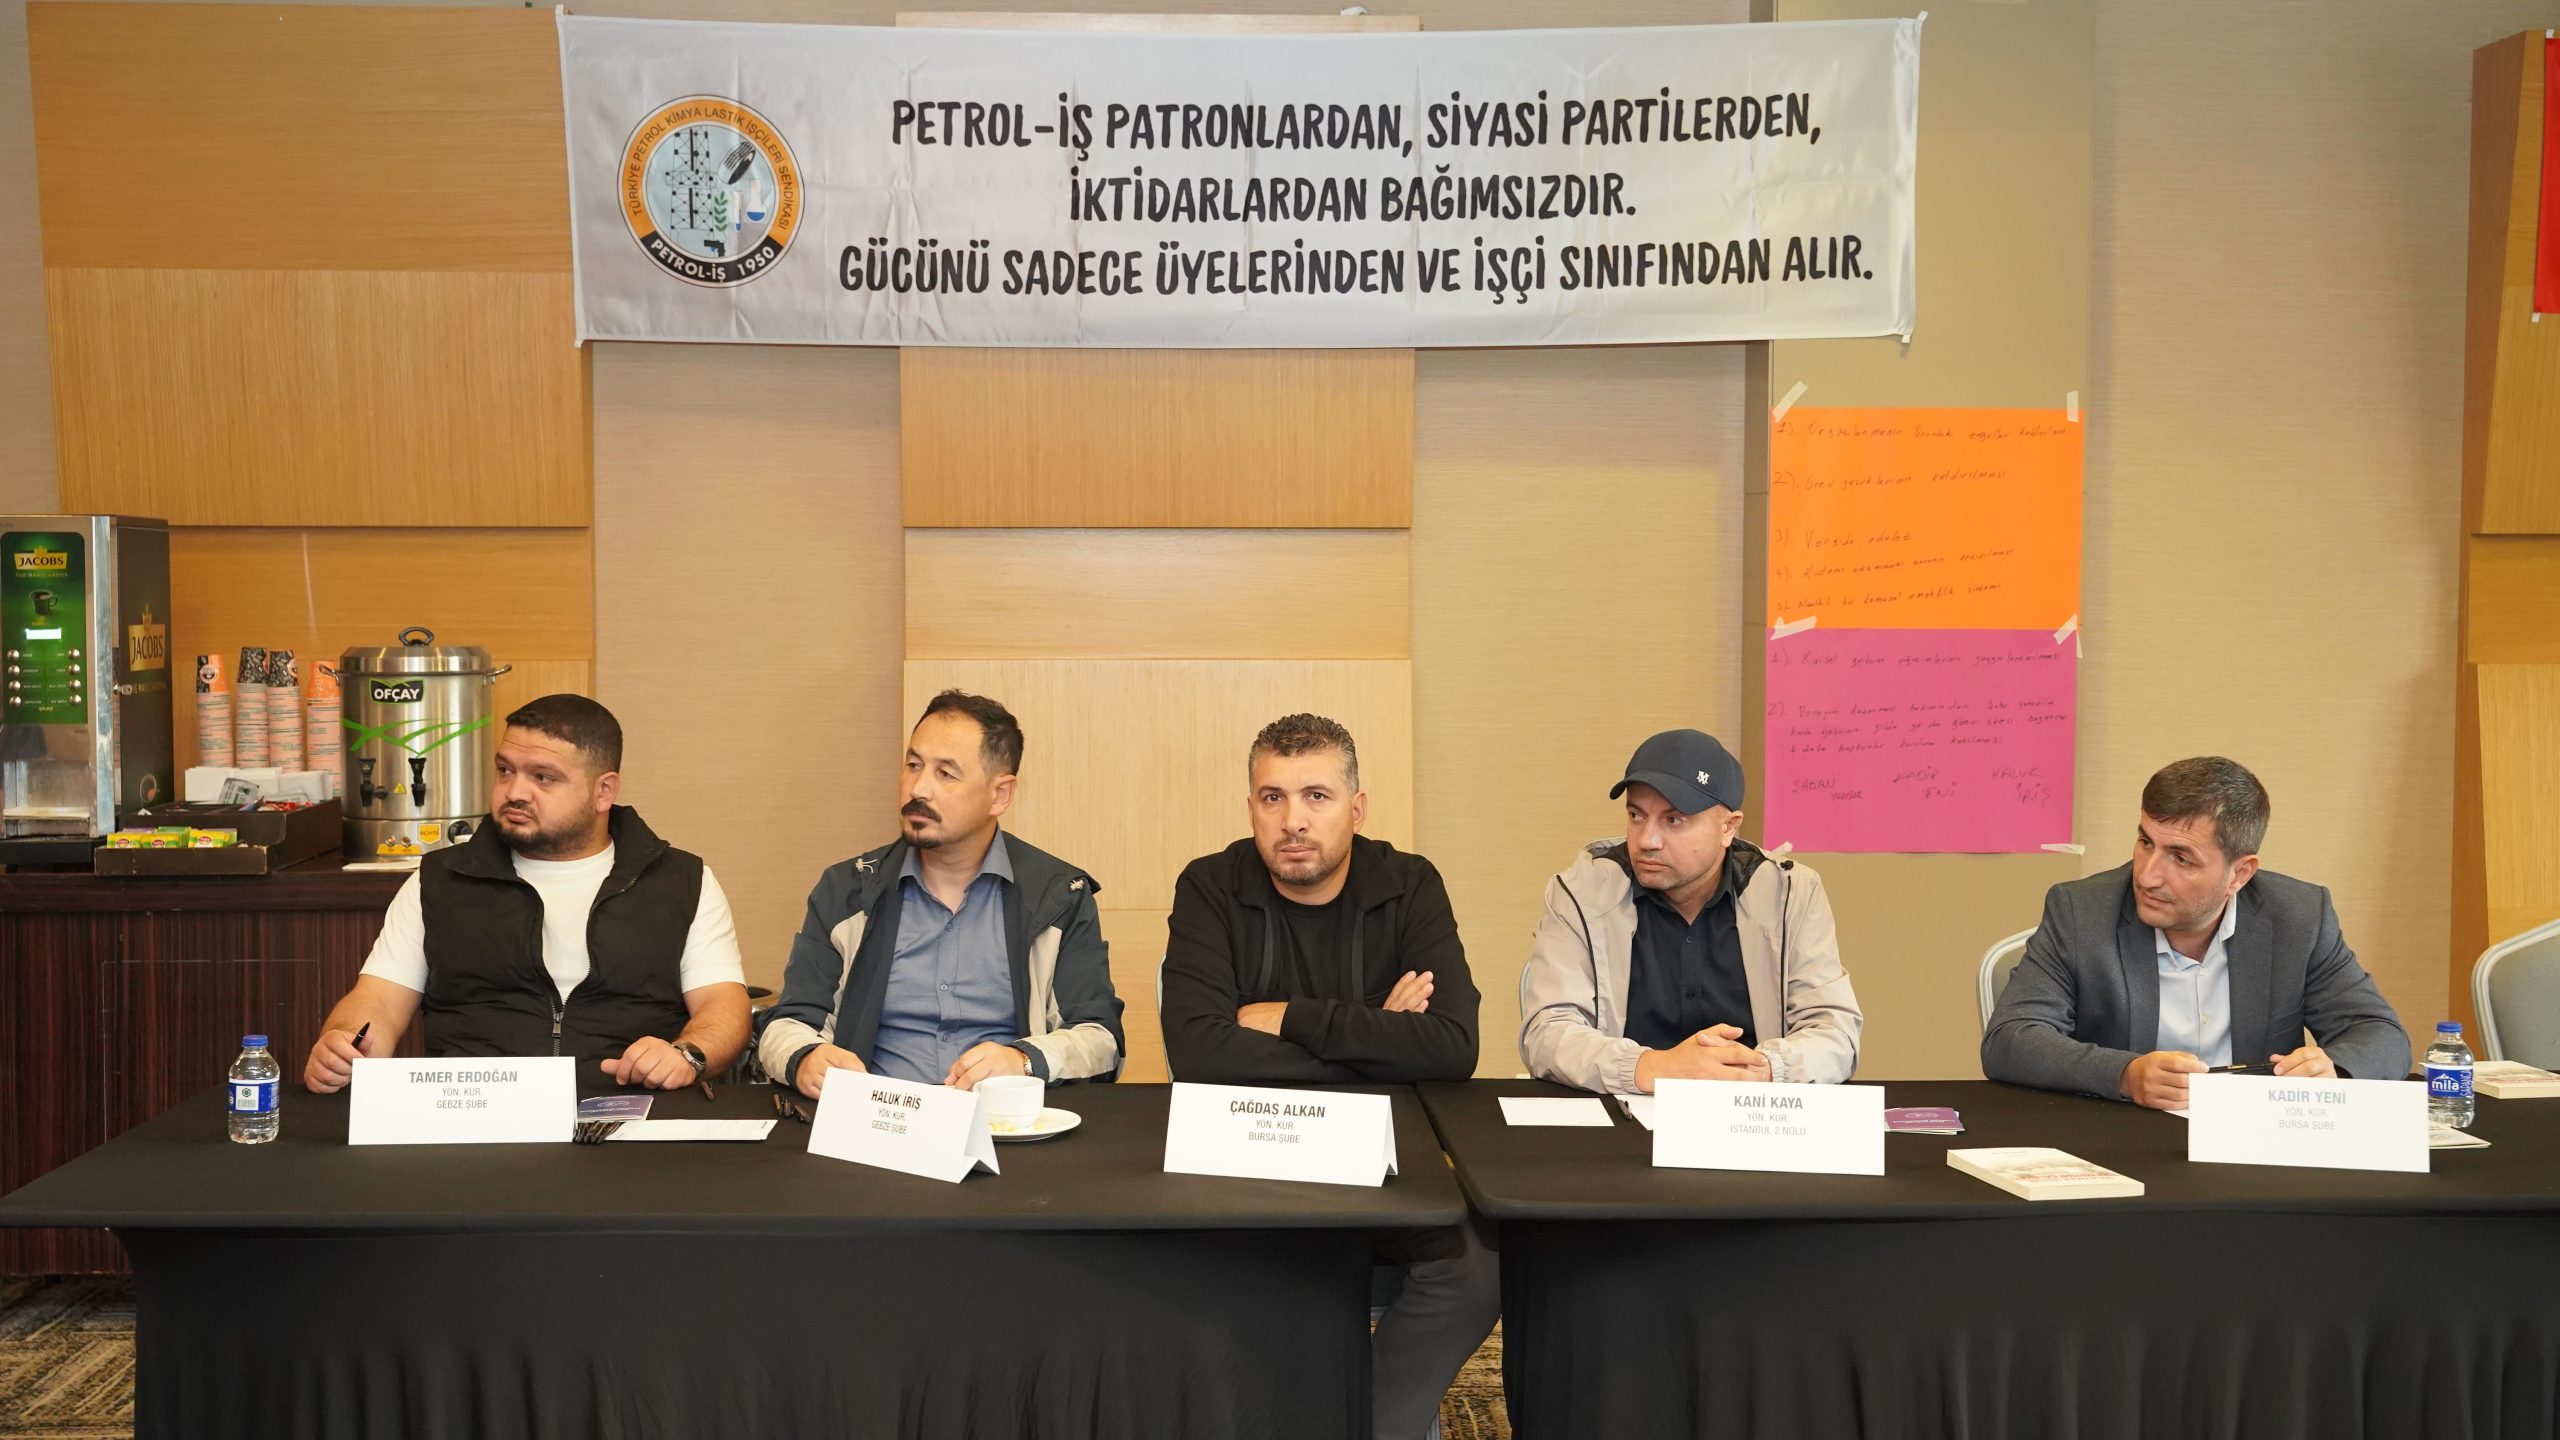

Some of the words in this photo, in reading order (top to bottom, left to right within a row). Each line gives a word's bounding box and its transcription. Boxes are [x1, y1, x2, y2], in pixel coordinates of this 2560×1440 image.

[893, 93, 1092, 161] PETROL-İŞ
[1107, 104, 1412, 157] PATRONLARDAN,
[1428, 90, 1547, 148] SİYASİ
[1563, 87, 1820, 145] PARTİLERDEN,
[628, 163, 641, 216] TÜRKİYE
[635, 124, 665, 162] PETROL
[666, 107, 701, 125] KİMYA
[705, 108, 743, 126] LASTİK
[745, 120, 784, 162] İŞÇİLERİ
[778, 166, 794, 230] SENDİKASI
[1071, 166, 1366, 223] İKTİDARLARDAN
[1381, 164, 1635, 221] BAĞIMSIZDIR.
[651, 239, 726, 283] PETROL-İŞ
[737, 246, 775, 276] 1950
[840, 238, 989, 293] GÜCÜNÜ
[1003, 250, 1142, 295] SADECE
[1157, 239, 1403, 294] ÜYELERİNDEN
[1418, 249, 1460, 292] VE
[1475, 236, 1545, 304] İŞÇİ
[1560, 239, 1770, 290] SINIFINDAN
[1783, 235, 1872, 281] ALIR.
[19, 557, 64, 567] JACOBS
[131, 635, 163, 664] JACOBS
[374, 689, 420, 702] OFÇAY
[409, 1072, 453, 1083] TAMER
[457, 1069, 518, 1083] ERDOĞAN
[2432, 1080, 2459, 1090] mila
[871, 1090, 901, 1106] HALUK
[902, 1092, 922, 1112] İRİŞ
[1734, 1093, 1766, 1108] KANİ
[1771, 1096, 1803, 1109] KAYA
[2268, 1088, 2310, 1102] KADİR
[2315, 1089, 2346, 1104] YENİ
[437, 1100, 463, 1109] GEBZE
[466, 1100, 488, 1110] ŞUBE
[1230, 1099, 1280, 1118] ÇAĞDAŞ
[1283, 1104, 1326, 1118] ALKAN
[871, 1119, 891, 1131] GEBZE
[1730, 1122, 1771, 1134] İSTANBUL
[1774, 1126, 1780, 1134] 2
[1782, 1126, 1806, 1136] NOLU
[2279, 1120, 2309, 1129] BURSA
[1249, 1131, 1276, 1141] BURSA
